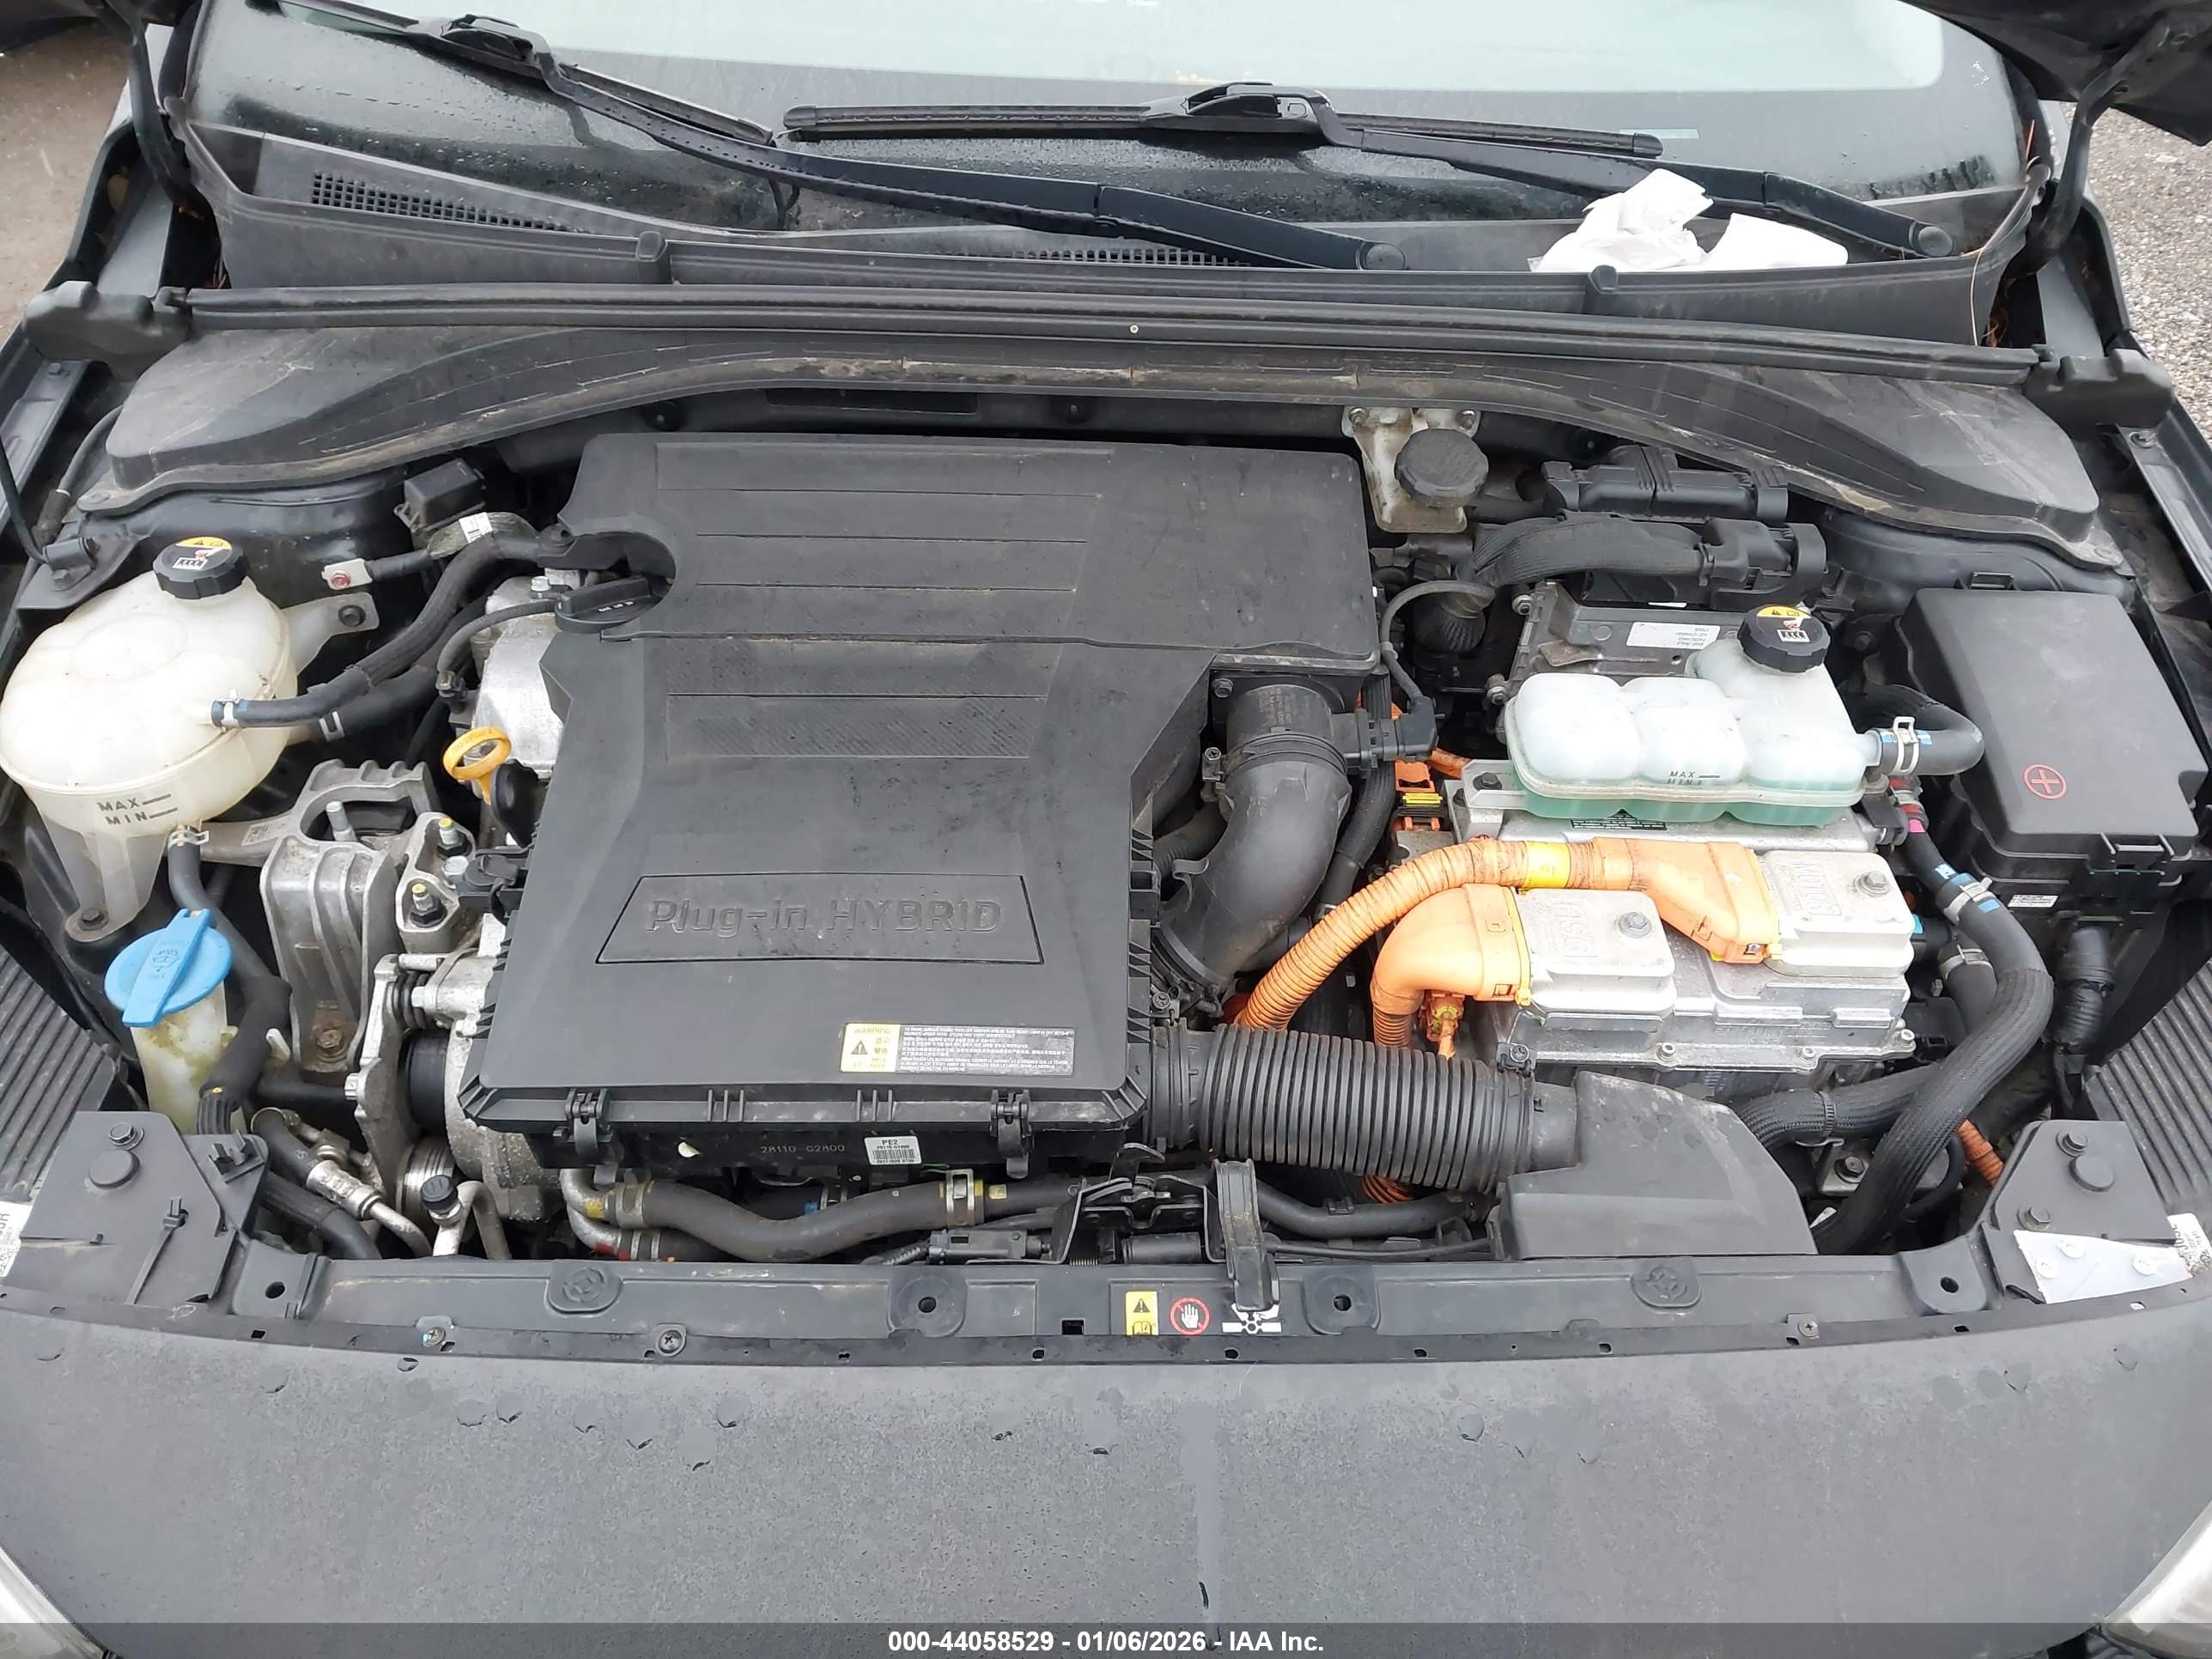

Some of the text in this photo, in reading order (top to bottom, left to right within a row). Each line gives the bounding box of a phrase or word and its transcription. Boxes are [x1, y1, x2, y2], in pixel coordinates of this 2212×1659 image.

[97, 798, 140, 811] MAX
[105, 811, 148, 824] MIN
[646, 899, 1002, 939] Plug-in HYBRID
